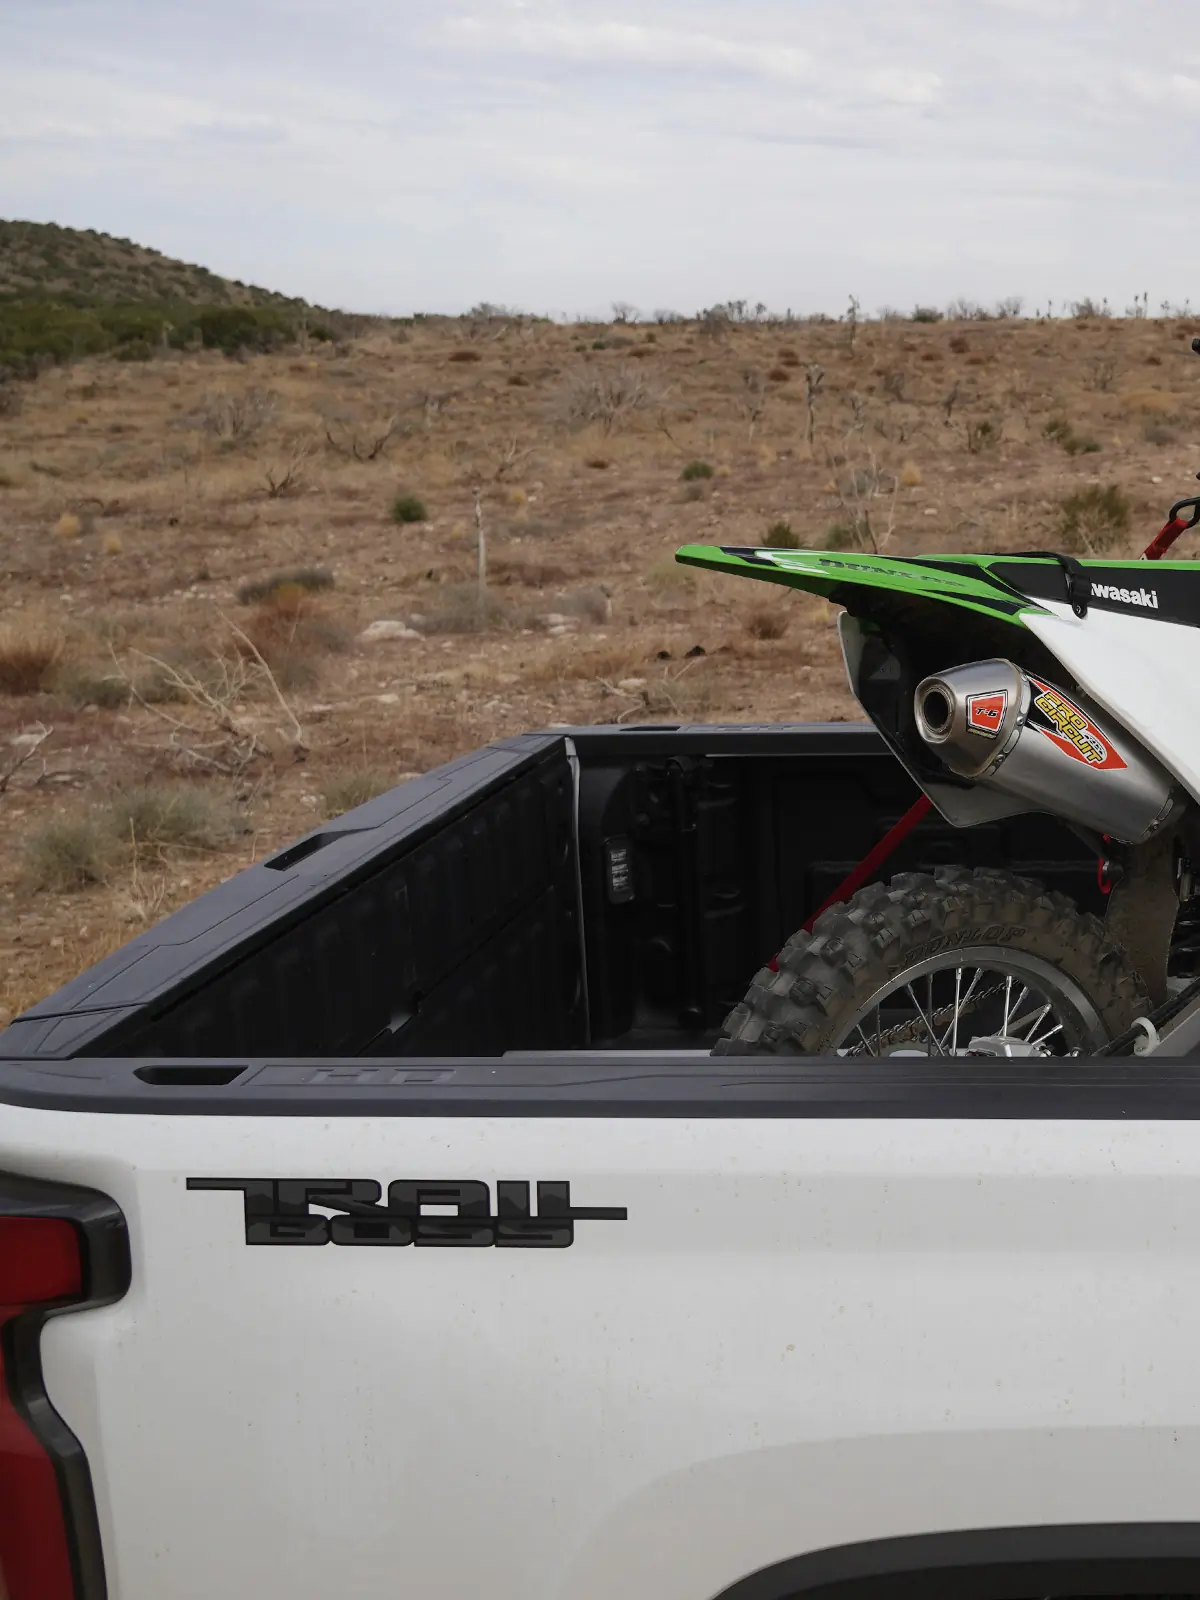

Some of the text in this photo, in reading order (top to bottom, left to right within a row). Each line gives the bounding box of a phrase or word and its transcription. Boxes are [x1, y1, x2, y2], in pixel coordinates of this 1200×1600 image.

[1091, 582, 1159, 609] wasaki
[975, 707, 999, 718] T-6
[1043, 690, 1088, 731] PRO
[1036, 697, 1104, 763] CIRCUIT
[186, 1177, 628, 1218] TRAIL
[244, 1213, 575, 1249] BOSS
